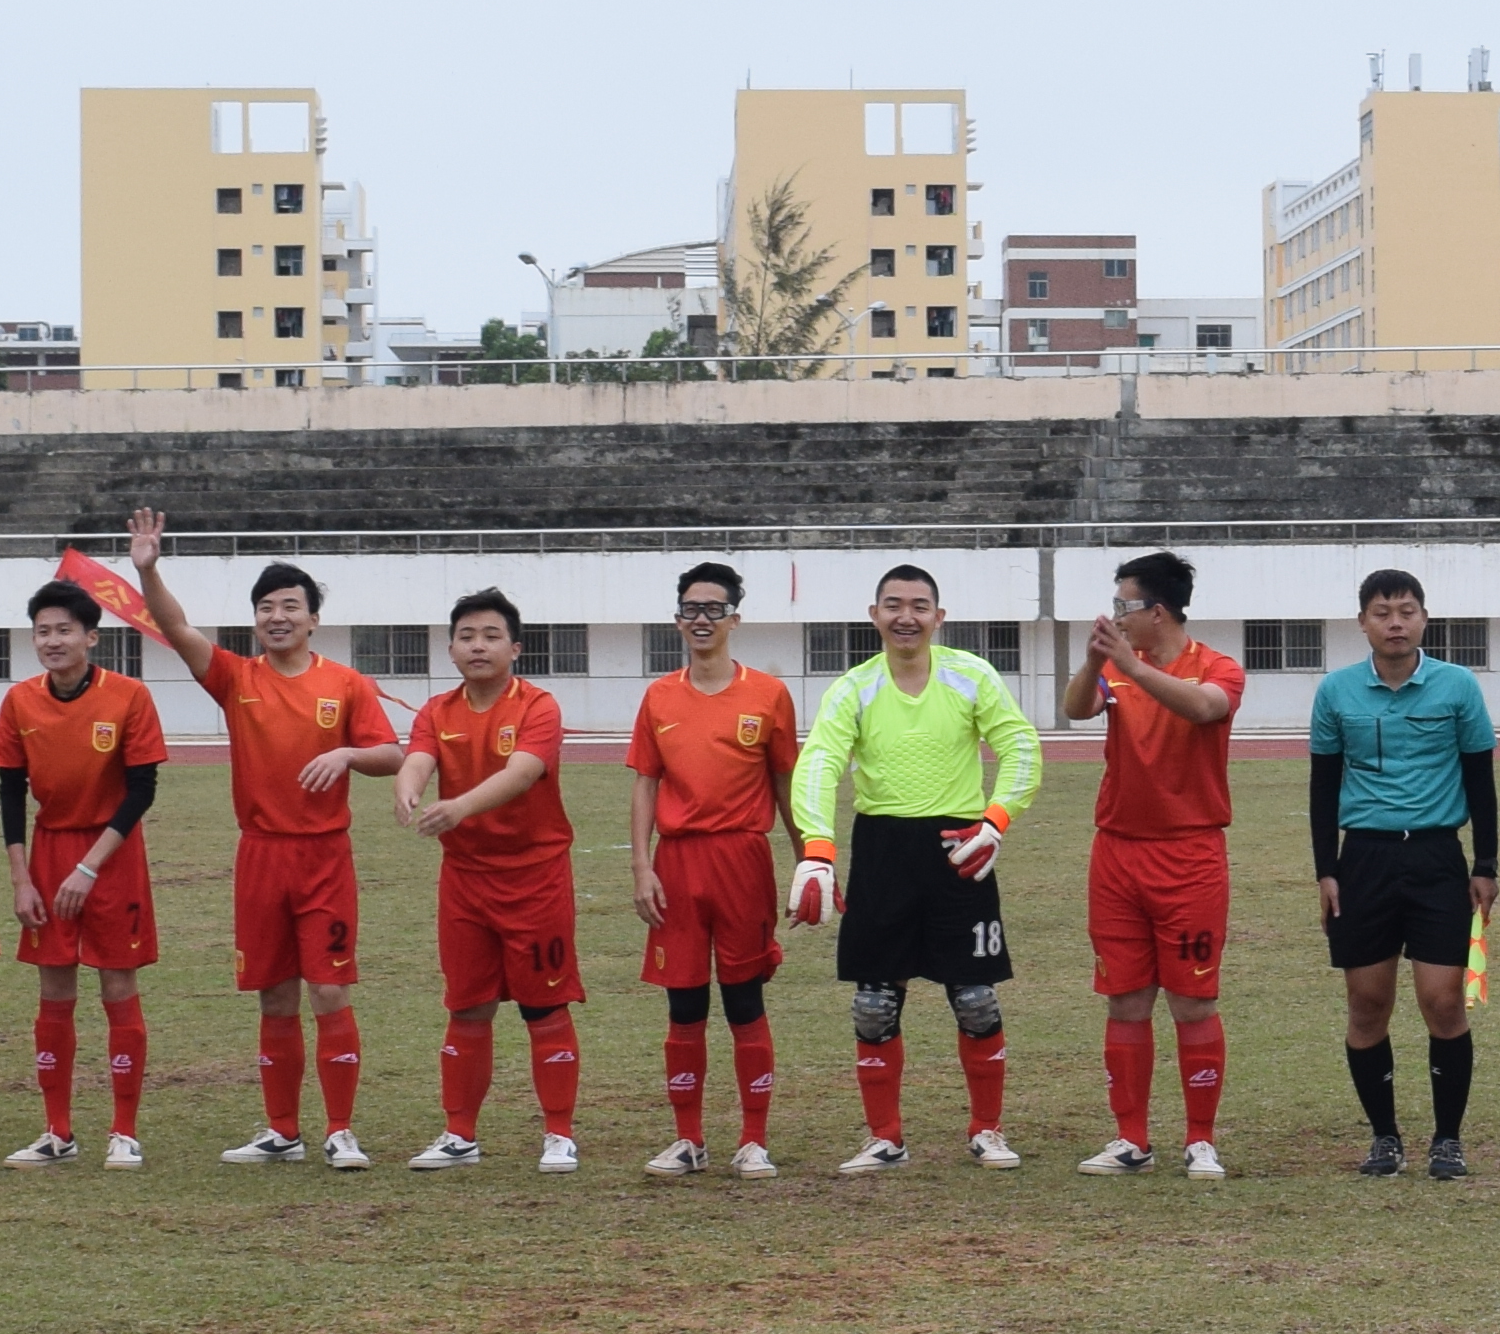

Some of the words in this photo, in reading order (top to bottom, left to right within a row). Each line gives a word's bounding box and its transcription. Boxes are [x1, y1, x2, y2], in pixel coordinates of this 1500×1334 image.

[126, 902, 141, 936] 7
[327, 919, 349, 953] 2
[529, 936, 565, 972] 10
[972, 920, 1002, 958] 18
[1177, 931, 1214, 963] 16
